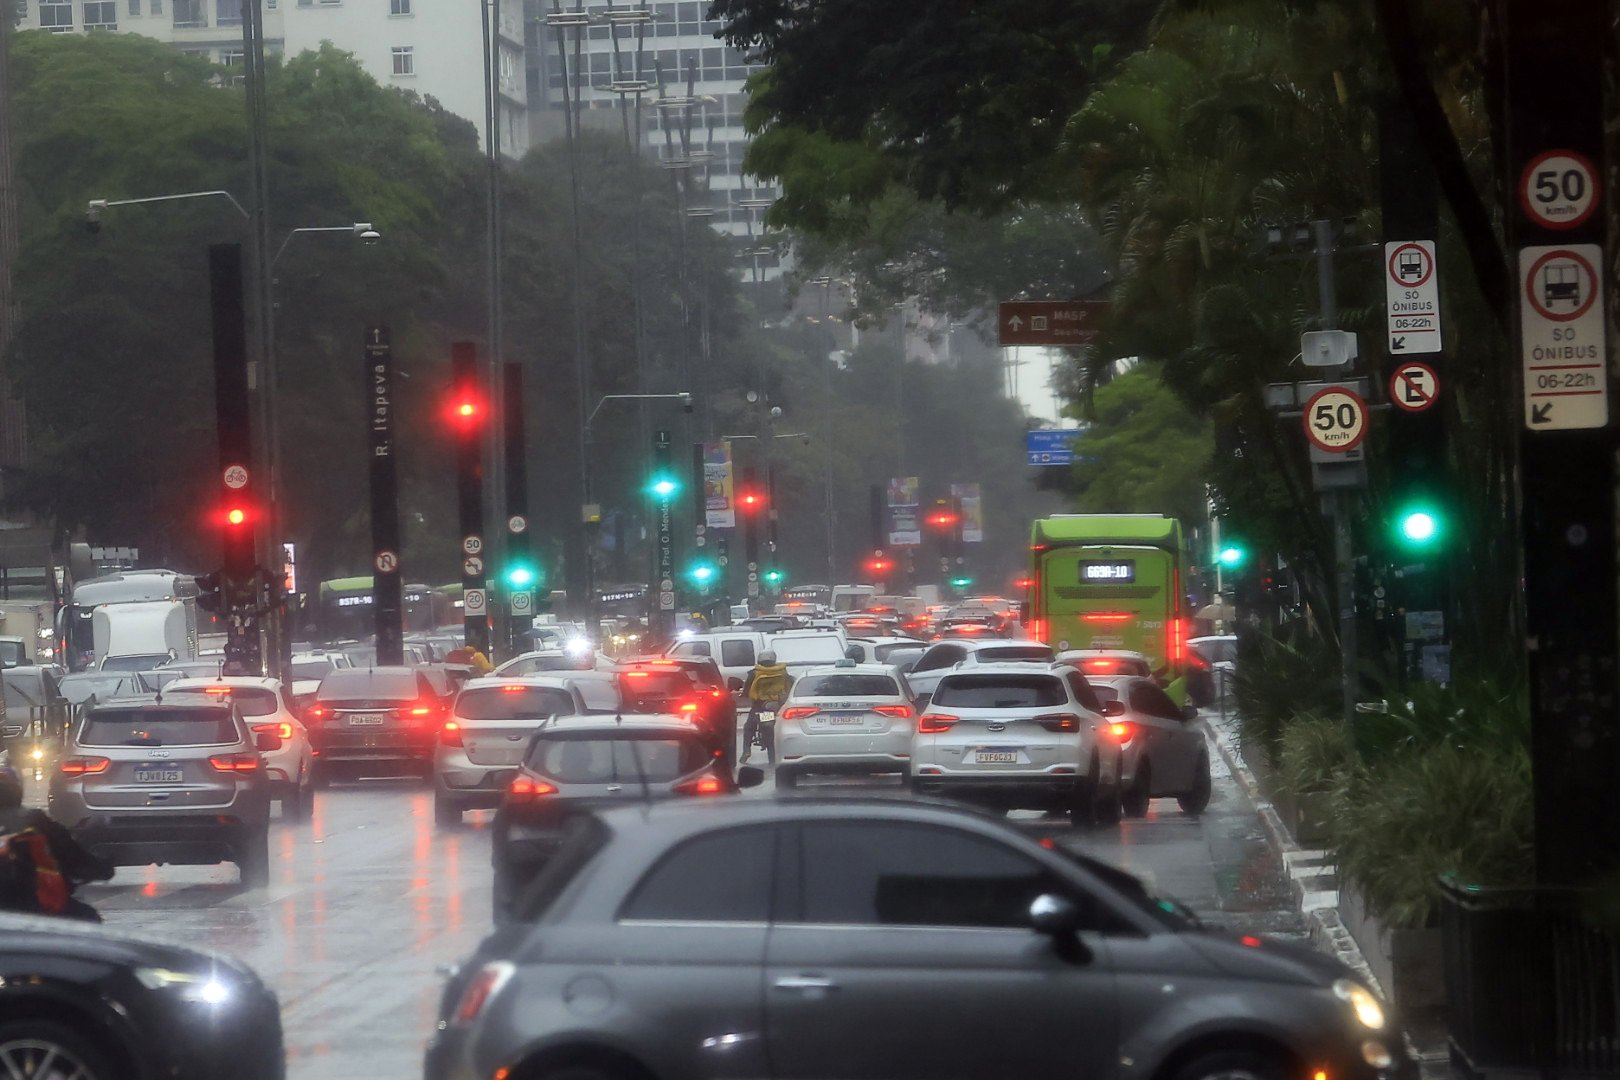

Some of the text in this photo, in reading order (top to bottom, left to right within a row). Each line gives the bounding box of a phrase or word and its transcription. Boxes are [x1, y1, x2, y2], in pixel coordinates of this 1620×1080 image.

[1536, 170, 1585, 203] 50
[1546, 205, 1577, 215] km/h
[1054, 310, 1088, 320] MASP
[1395, 318, 1431, 328] 06-22h
[1538, 373, 1595, 389] 06-22h
[374, 365, 389, 430] Itapeva
[1314, 403, 1356, 430] 50
[1324, 432, 1349, 440] km/h
[375, 440, 388, 456] R.
[466, 539, 480, 549] 50
[469, 594, 480, 603] 20
[515, 596, 526, 605] 20
[149, 749, 169, 758] Jeep
